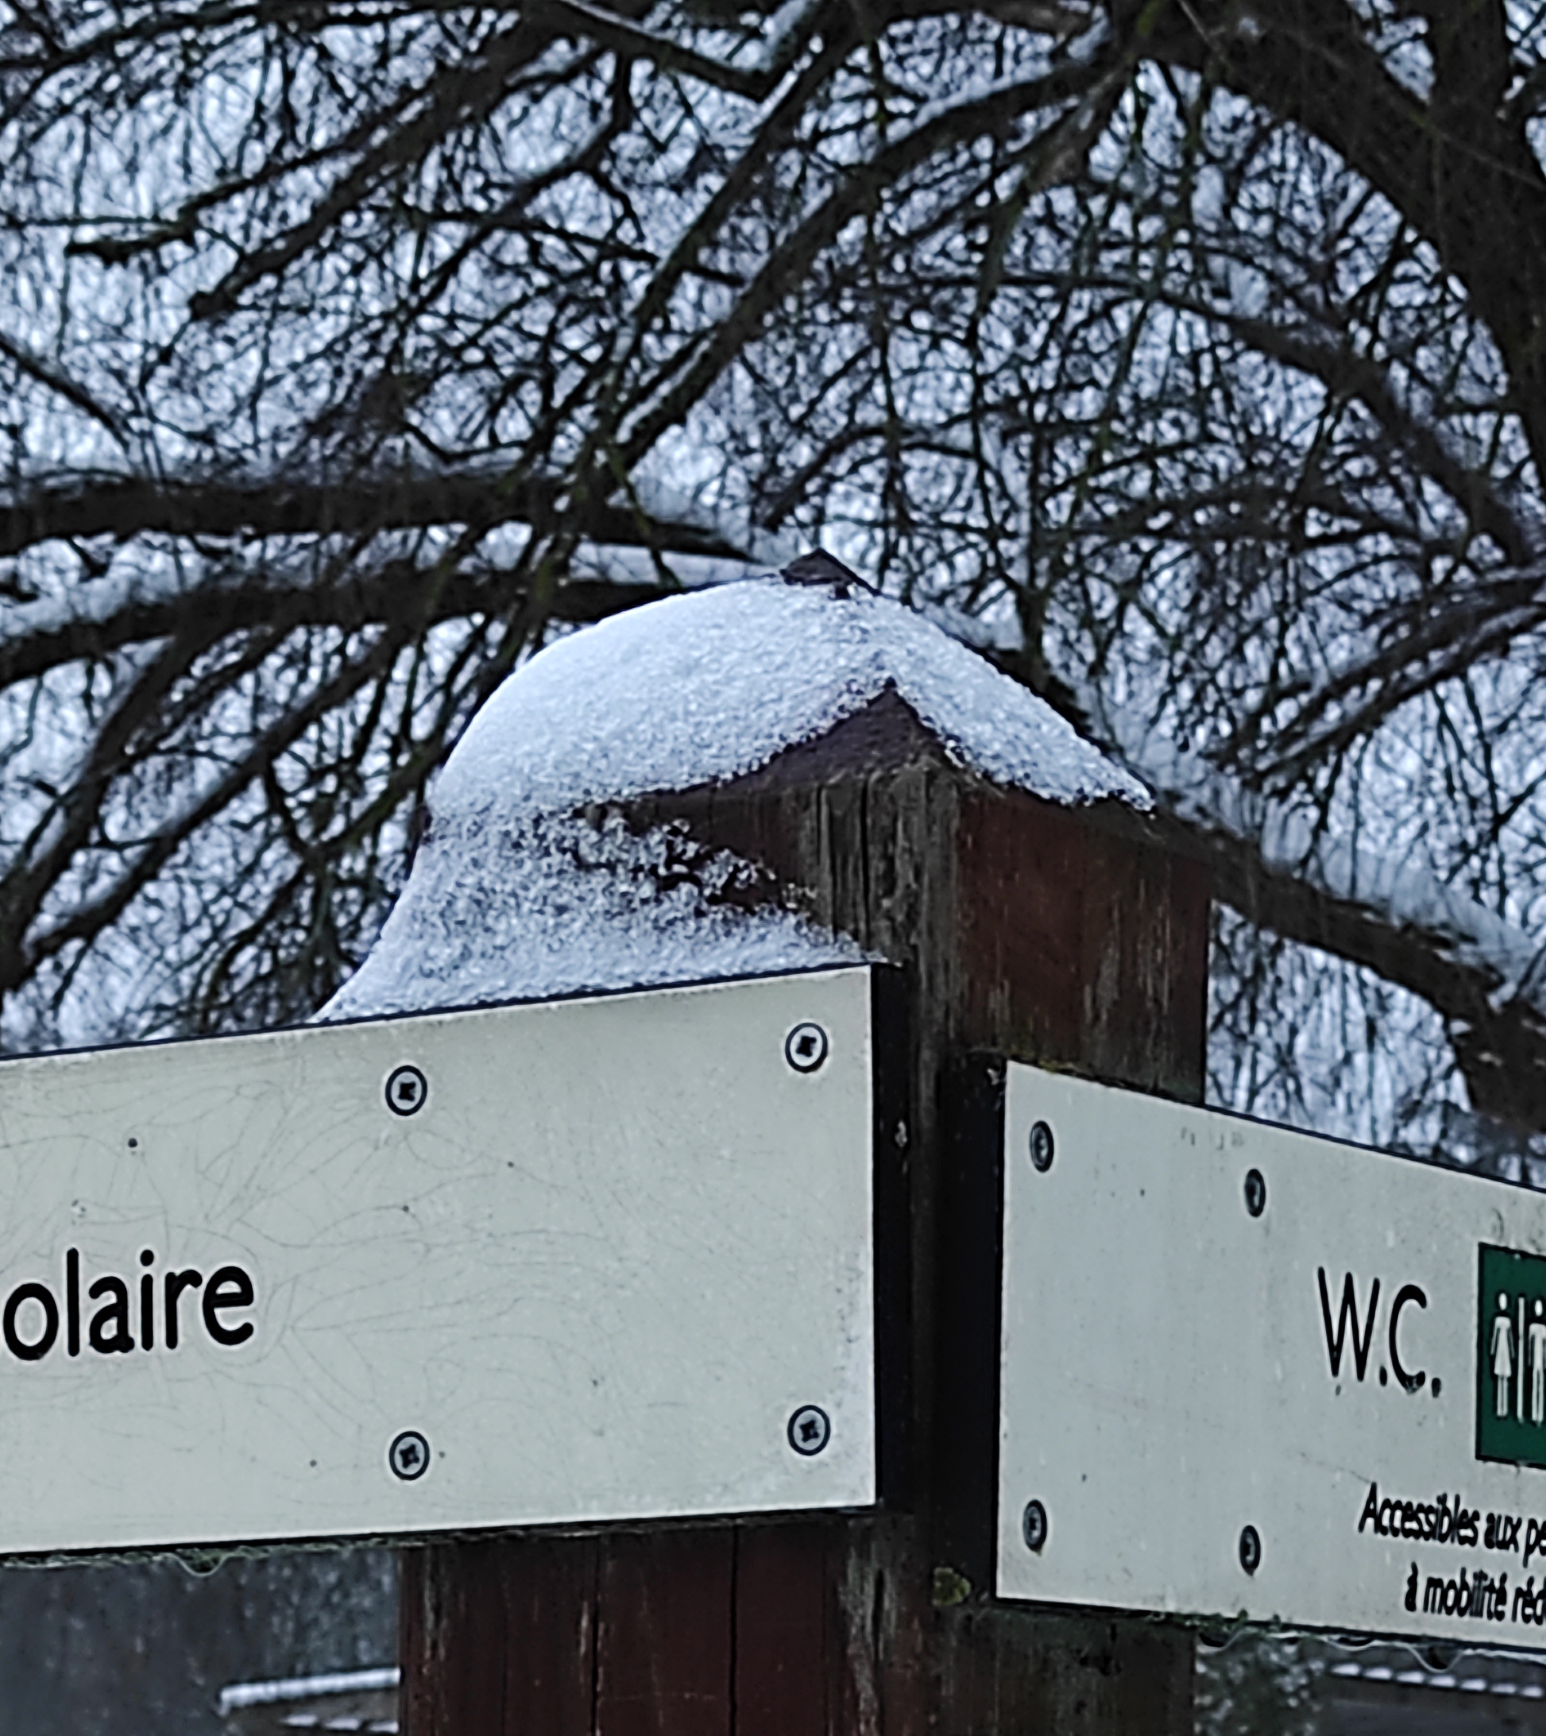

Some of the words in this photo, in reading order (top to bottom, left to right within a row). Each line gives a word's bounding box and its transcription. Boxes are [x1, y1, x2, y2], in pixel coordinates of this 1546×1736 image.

[1317, 1266, 1442, 1398] W.C.
[1357, 1481, 1480, 1547] Accessibles
[1484, 1512, 1521, 1553] aux
[1404, 1561, 1419, 1612] à
[1422, 1566, 1508, 1622] mobilité
